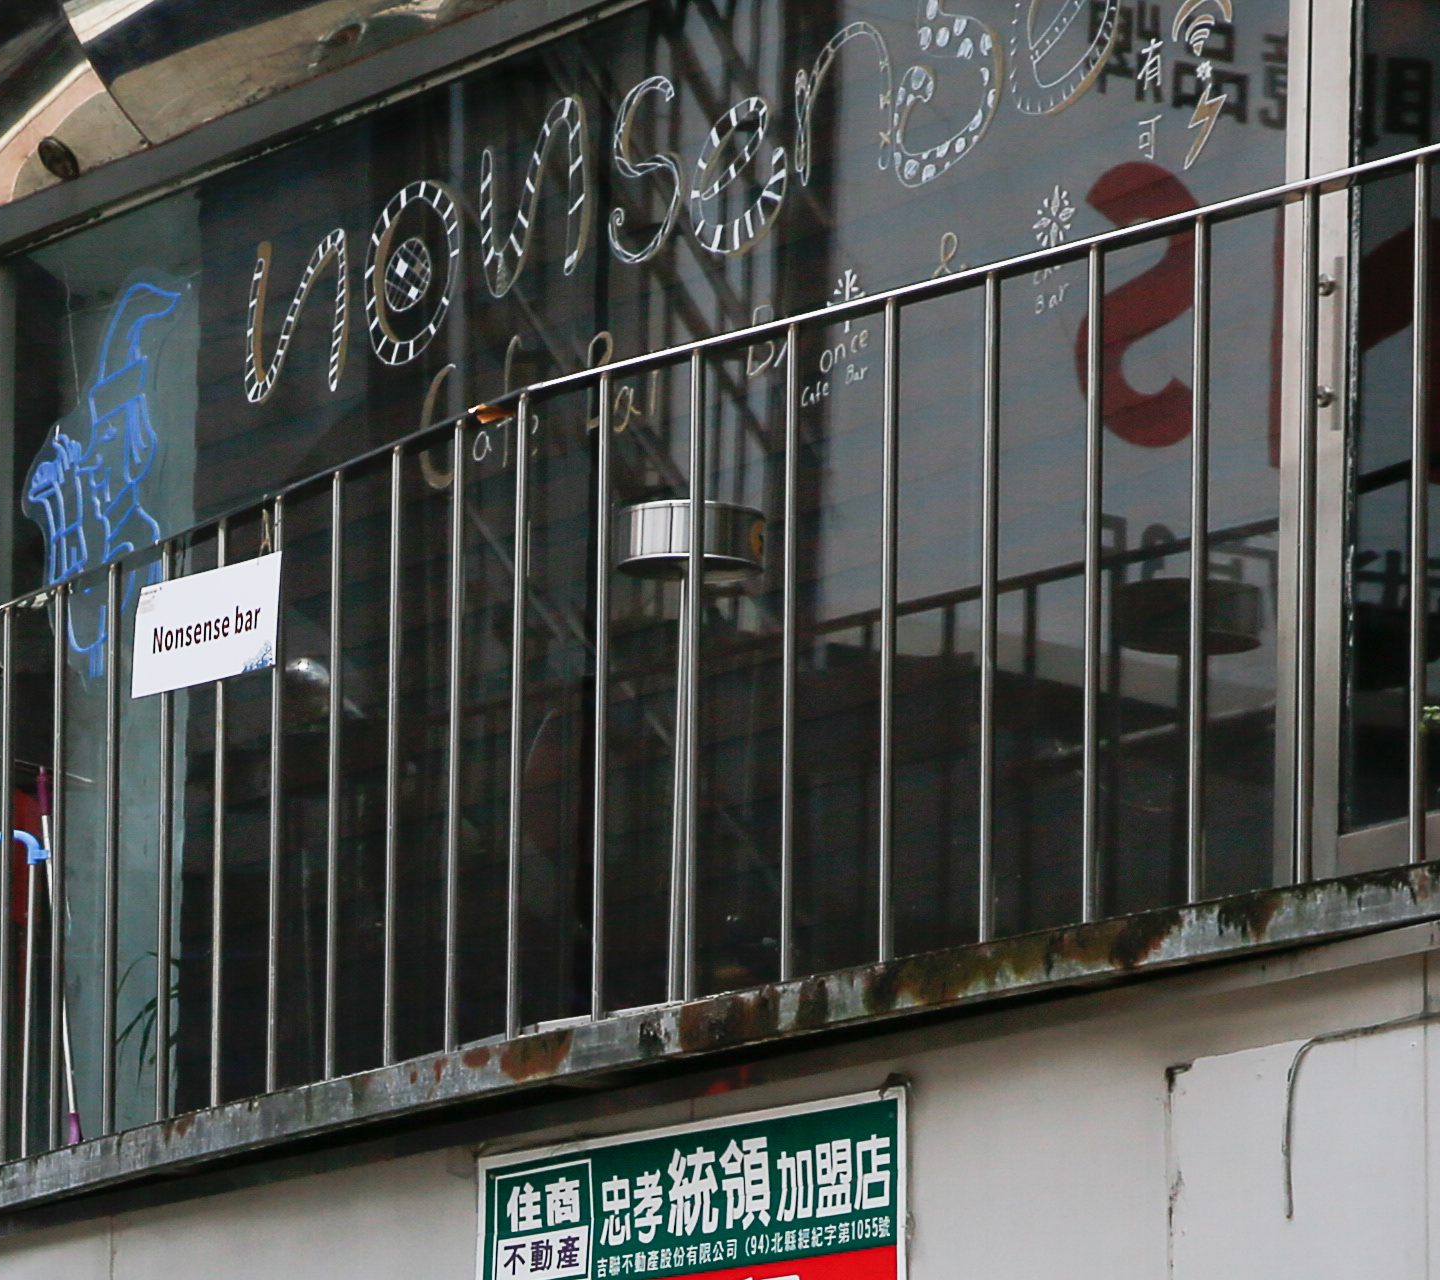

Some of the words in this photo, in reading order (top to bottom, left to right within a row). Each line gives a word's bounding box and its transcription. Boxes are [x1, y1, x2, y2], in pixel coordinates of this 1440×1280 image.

[1137, 38, 1164, 91] 有
[1138, 114, 1162, 160] 可
[153, 616, 230, 655] Nonsense
[235, 606, 261, 633] bar
[506, 1175, 582, 1233] 住商
[599, 1134, 892, 1247] 忠孝統領加盟店
[503, 1235, 581, 1276] 不動產
[597, 1238, 739, 1279] 吉聯不動產股份有限公司
